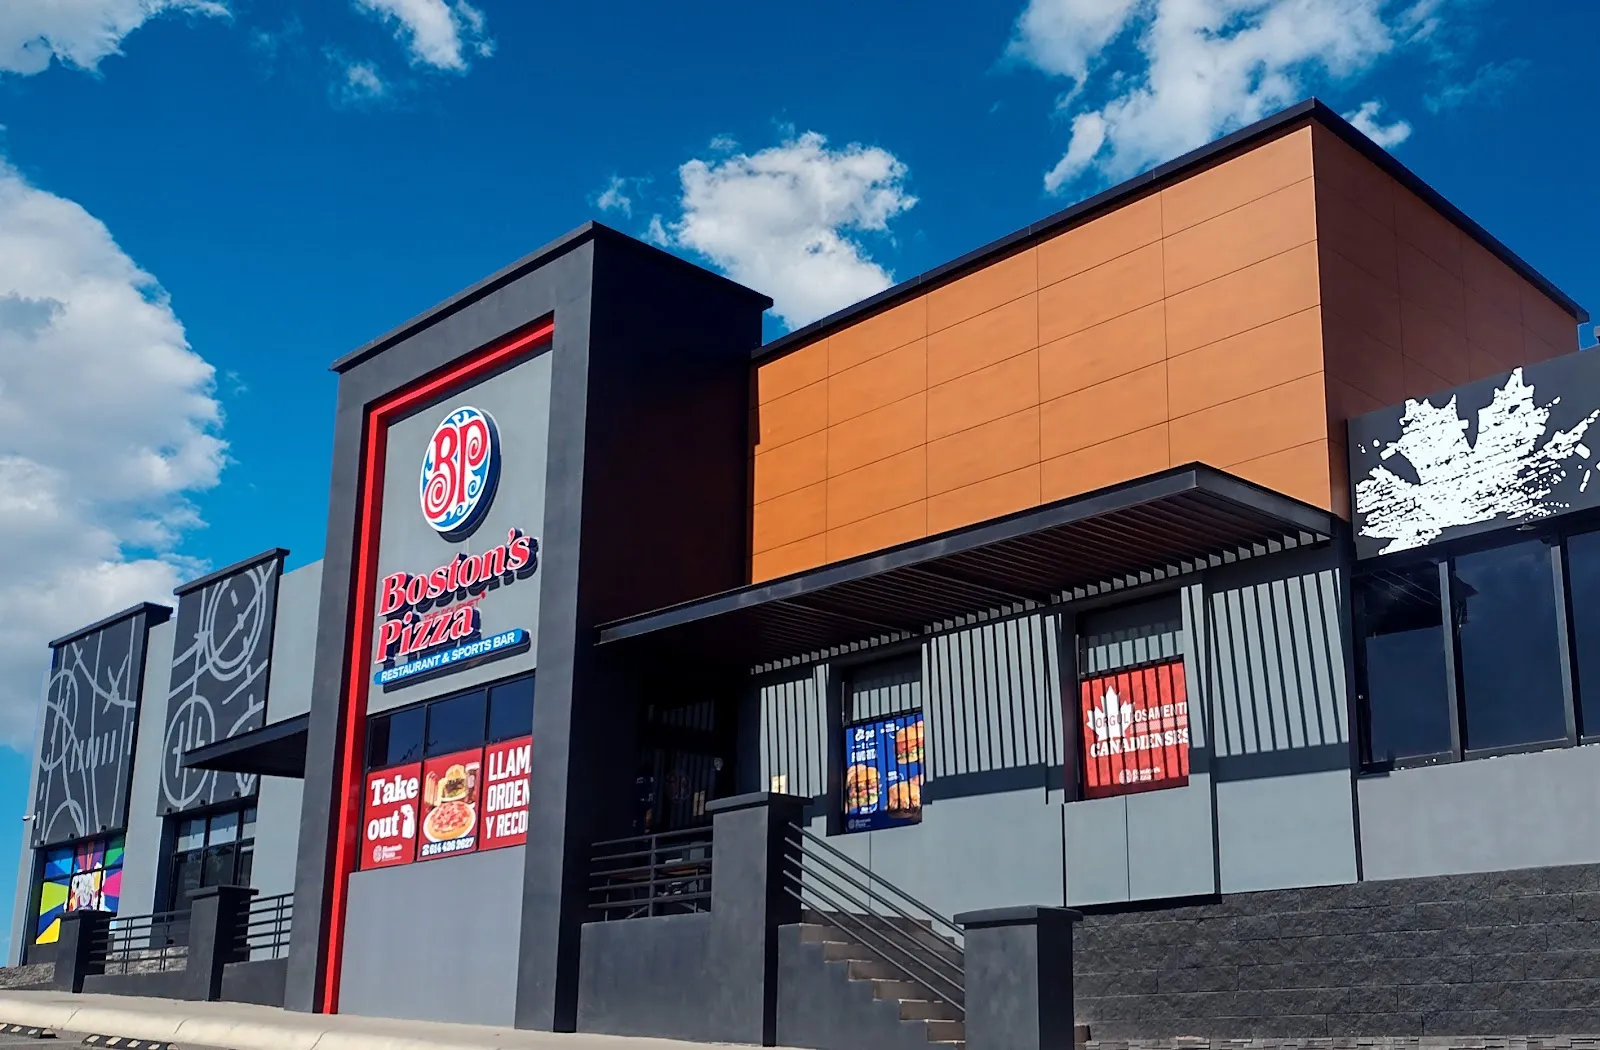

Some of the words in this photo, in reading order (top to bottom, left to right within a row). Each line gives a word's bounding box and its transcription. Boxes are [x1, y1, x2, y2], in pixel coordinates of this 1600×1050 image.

[422, 418, 489, 520] BP
[377, 527, 531, 617] Boston's
[374, 605, 474, 665] Pizza
[380, 655, 441, 683] RESTAURANT
[441, 653, 450, 664] &
[451, 639, 492, 661] SPORTS
[493, 632, 515, 648] BAR
[1090, 727, 1189, 758] CANADIENSES
[488, 745, 532, 782] LLAM
[371, 774, 419, 807] Take
[367, 809, 400, 841] out
[486, 815, 495, 840] Y
